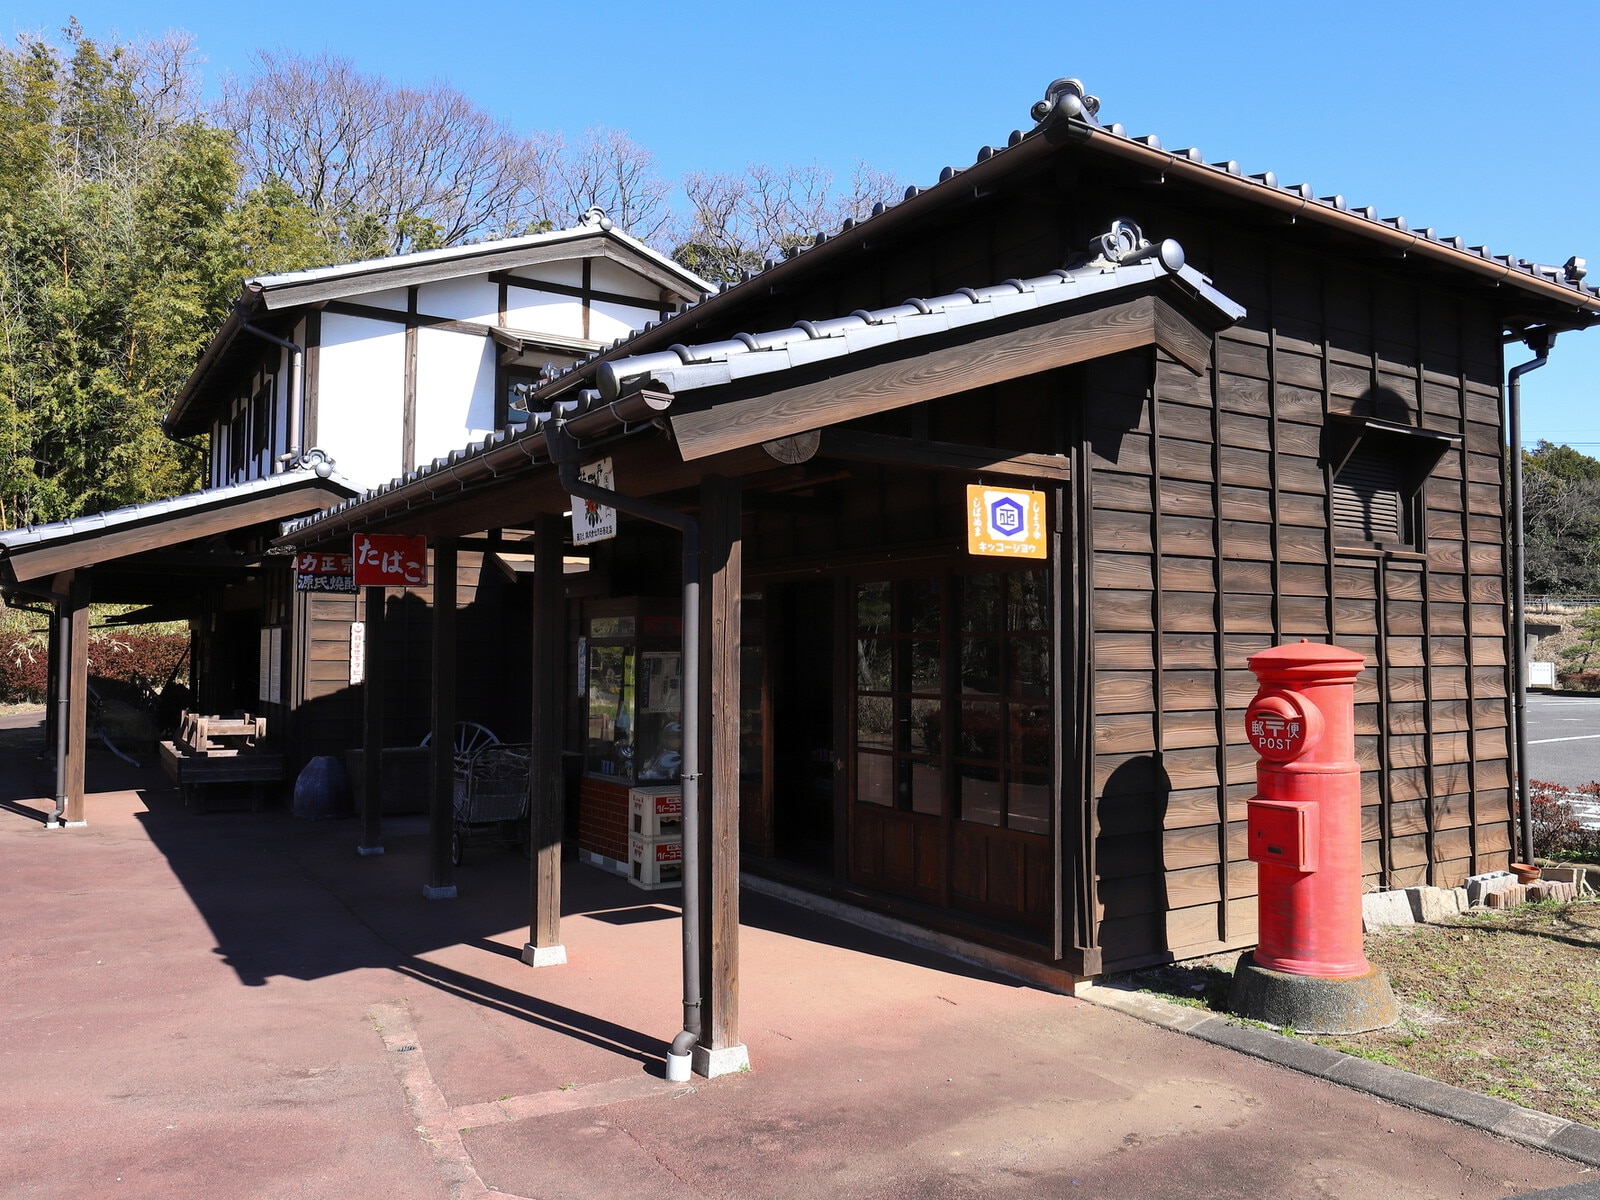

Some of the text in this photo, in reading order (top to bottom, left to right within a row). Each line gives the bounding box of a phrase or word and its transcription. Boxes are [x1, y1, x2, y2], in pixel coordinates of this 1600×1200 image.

[359, 539, 420, 582] たばこ
[1259, 738, 1292, 750] POST
